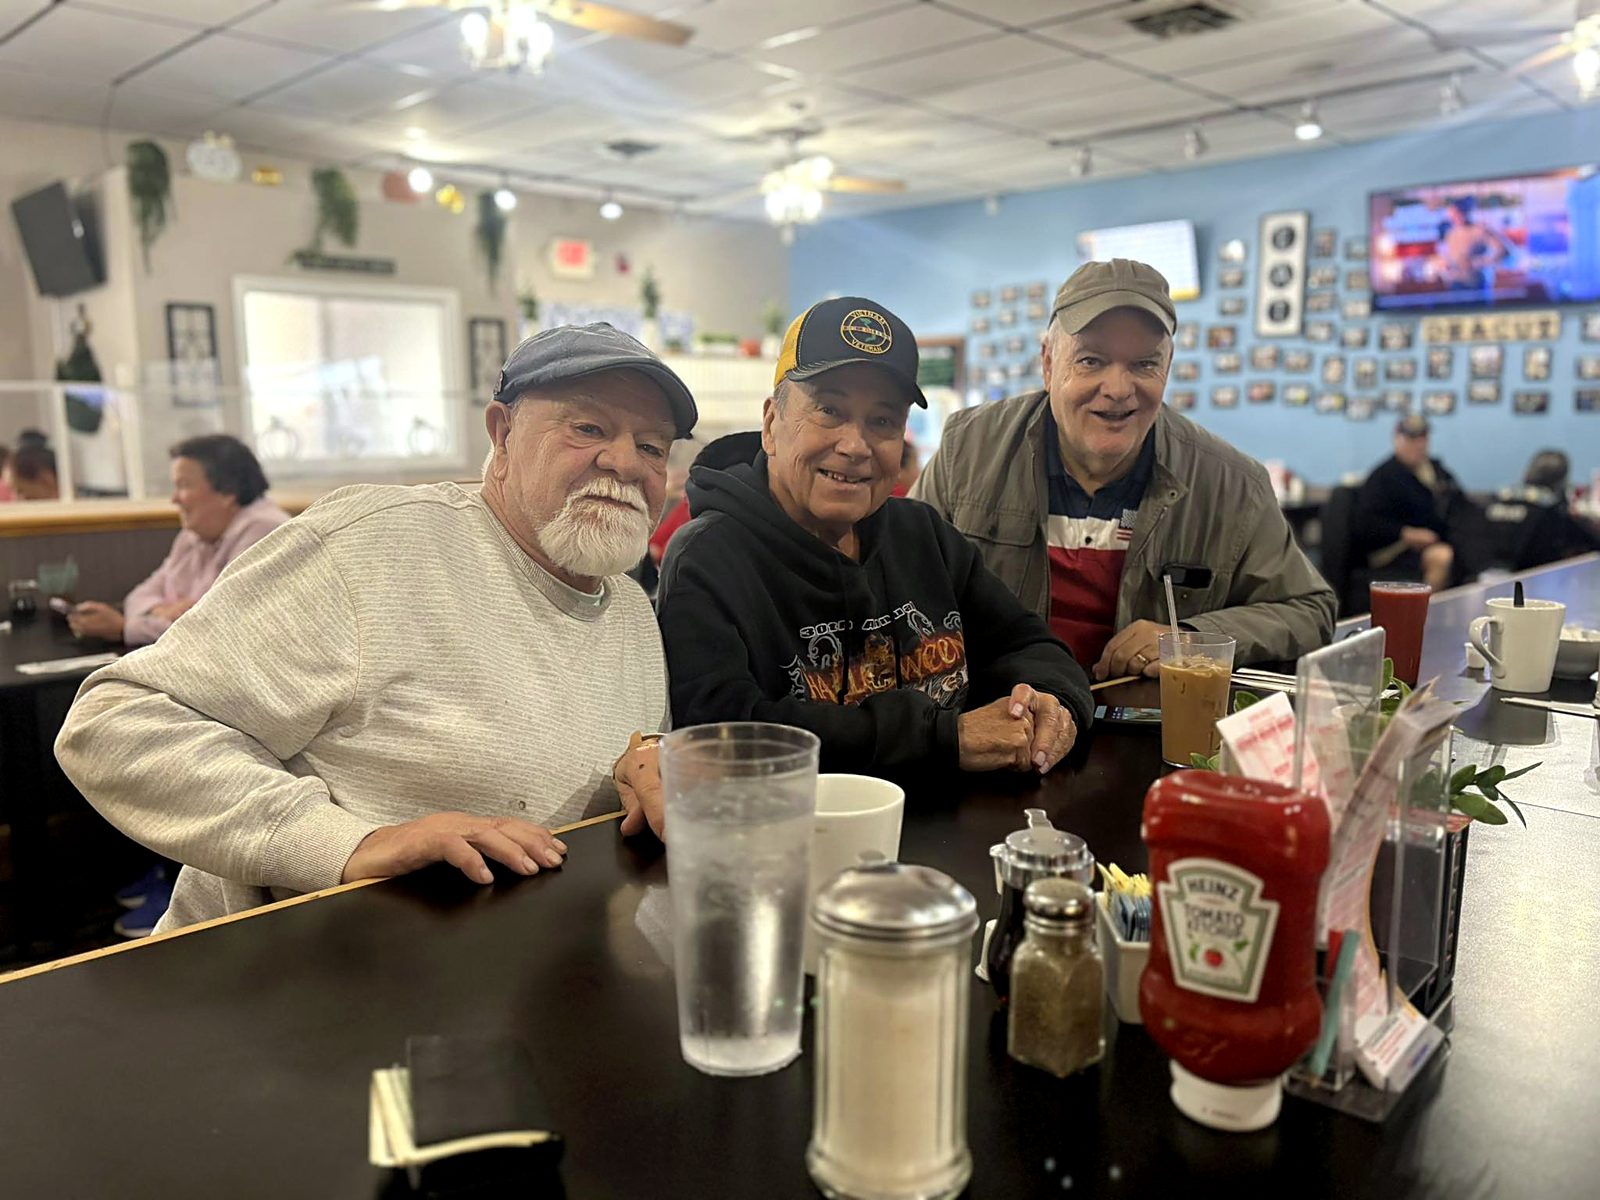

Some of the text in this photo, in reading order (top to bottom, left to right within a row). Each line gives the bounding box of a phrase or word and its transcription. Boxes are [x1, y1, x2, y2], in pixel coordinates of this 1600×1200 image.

[852, 340, 883, 352] VETERAN
[1186, 878, 1240, 902] HEINZ
[1184, 903, 1246, 929] TOMATO
